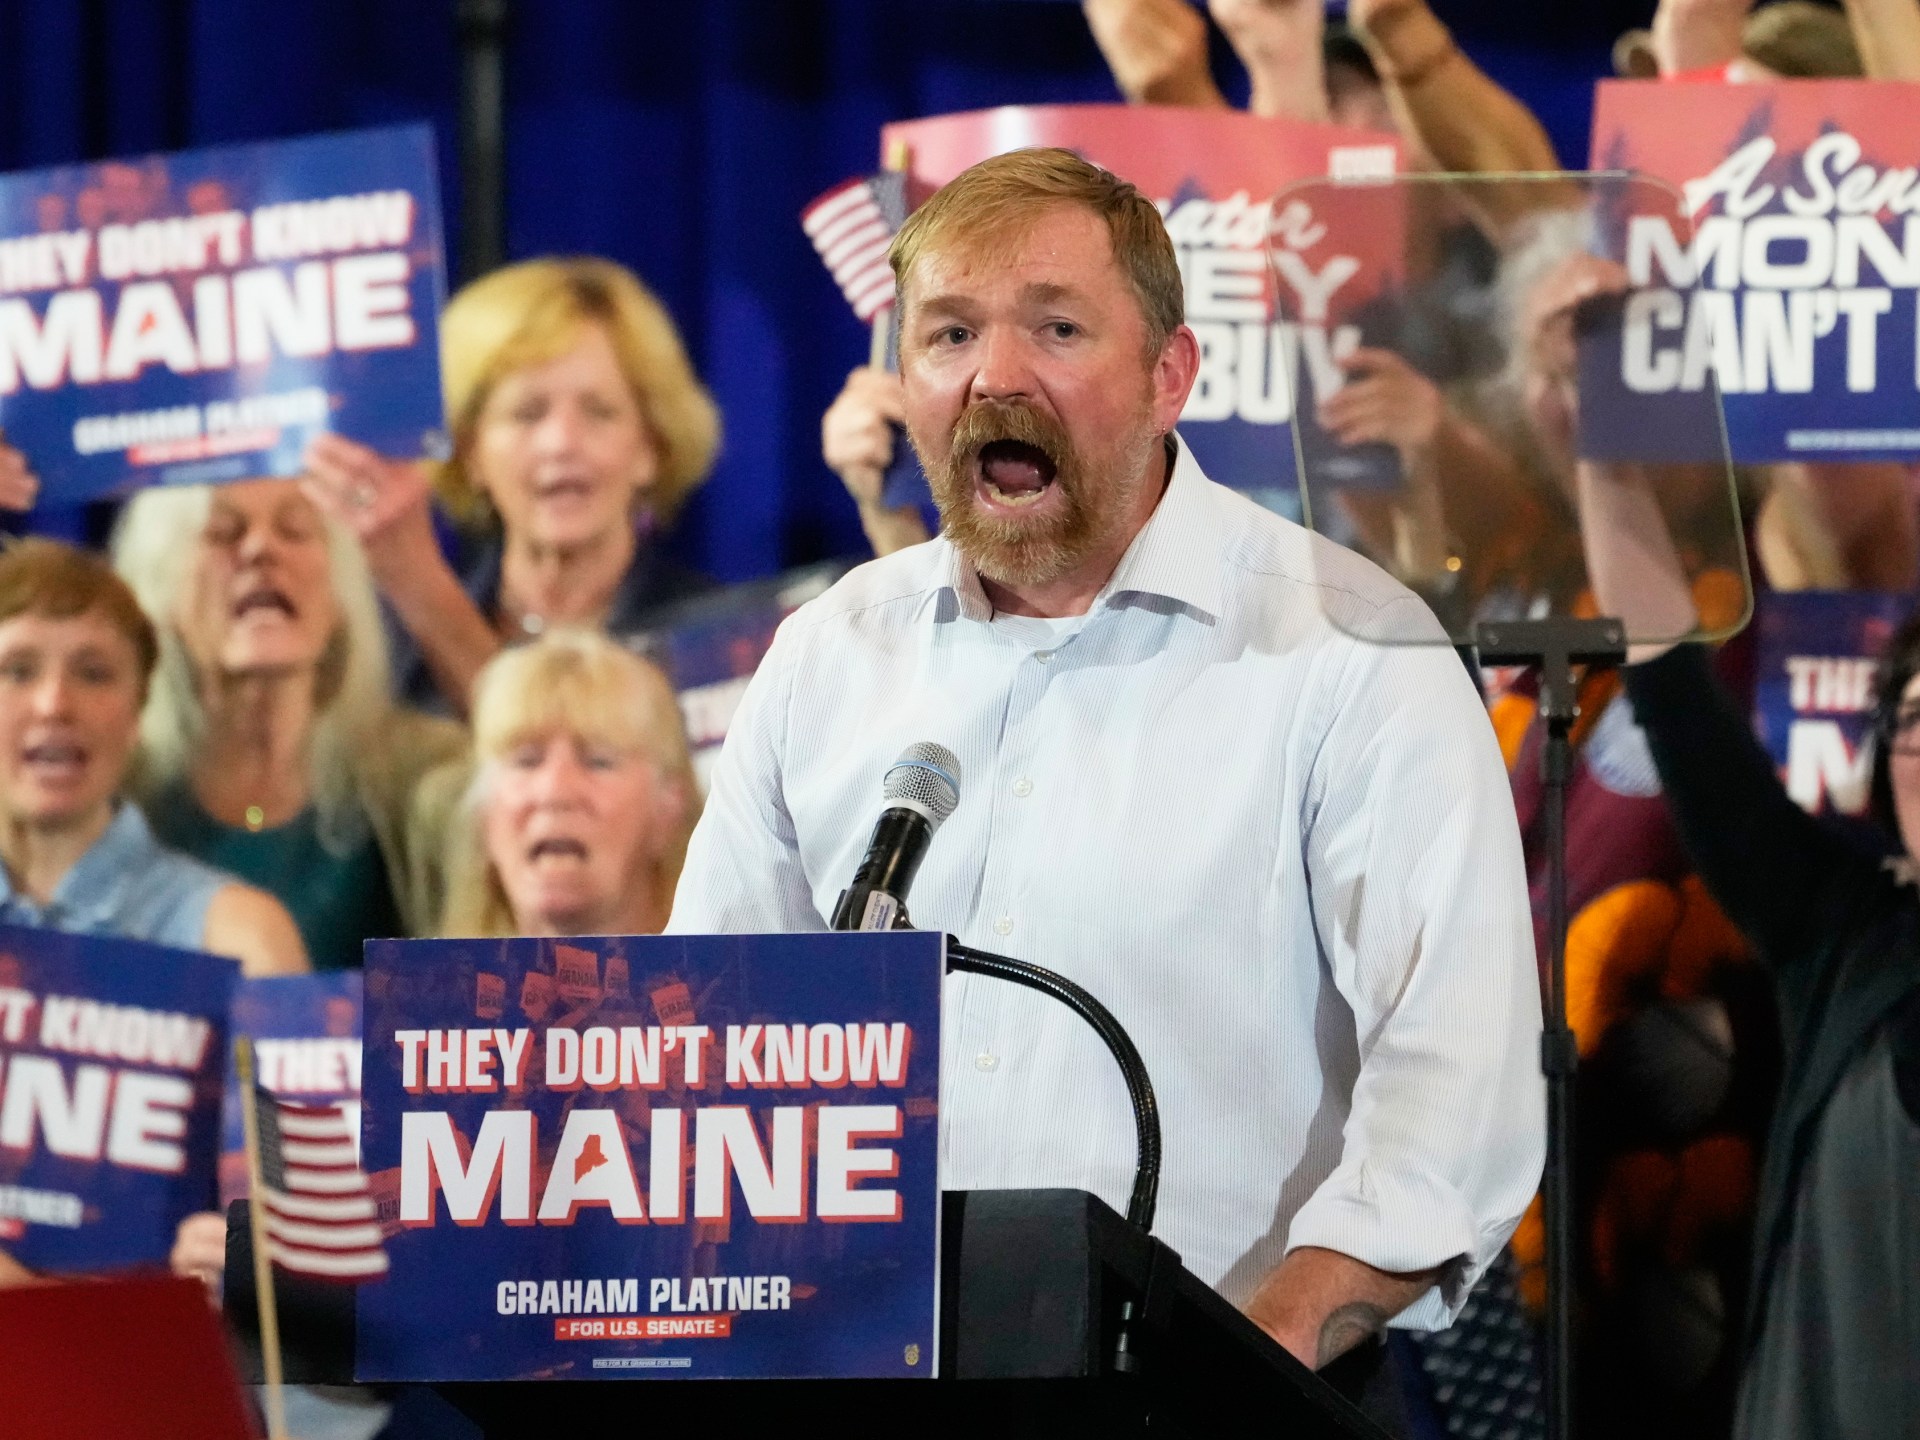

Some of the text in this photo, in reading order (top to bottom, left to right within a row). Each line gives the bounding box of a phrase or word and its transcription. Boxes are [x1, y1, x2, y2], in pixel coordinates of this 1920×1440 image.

[0, 190, 414, 293] HEY DON'T KNOW
[1628, 214, 1920, 290] MON
[1176, 248, 1361, 322] EY
[0, 252, 414, 395] MAINE
[1621, 287, 1893, 394] CAN'T
[1785, 656, 1879, 712] THE
[40, 993, 211, 1070] KNOW
[394, 1022, 908, 1091] THEY DON'T KNOW
[0, 1055, 194, 1174] NE
[399, 1104, 902, 1224] MAINE
[496, 1275, 792, 1315] GRAHAM PLATNER
[569, 1318, 716, 1337] FOR U.S. SENATE
